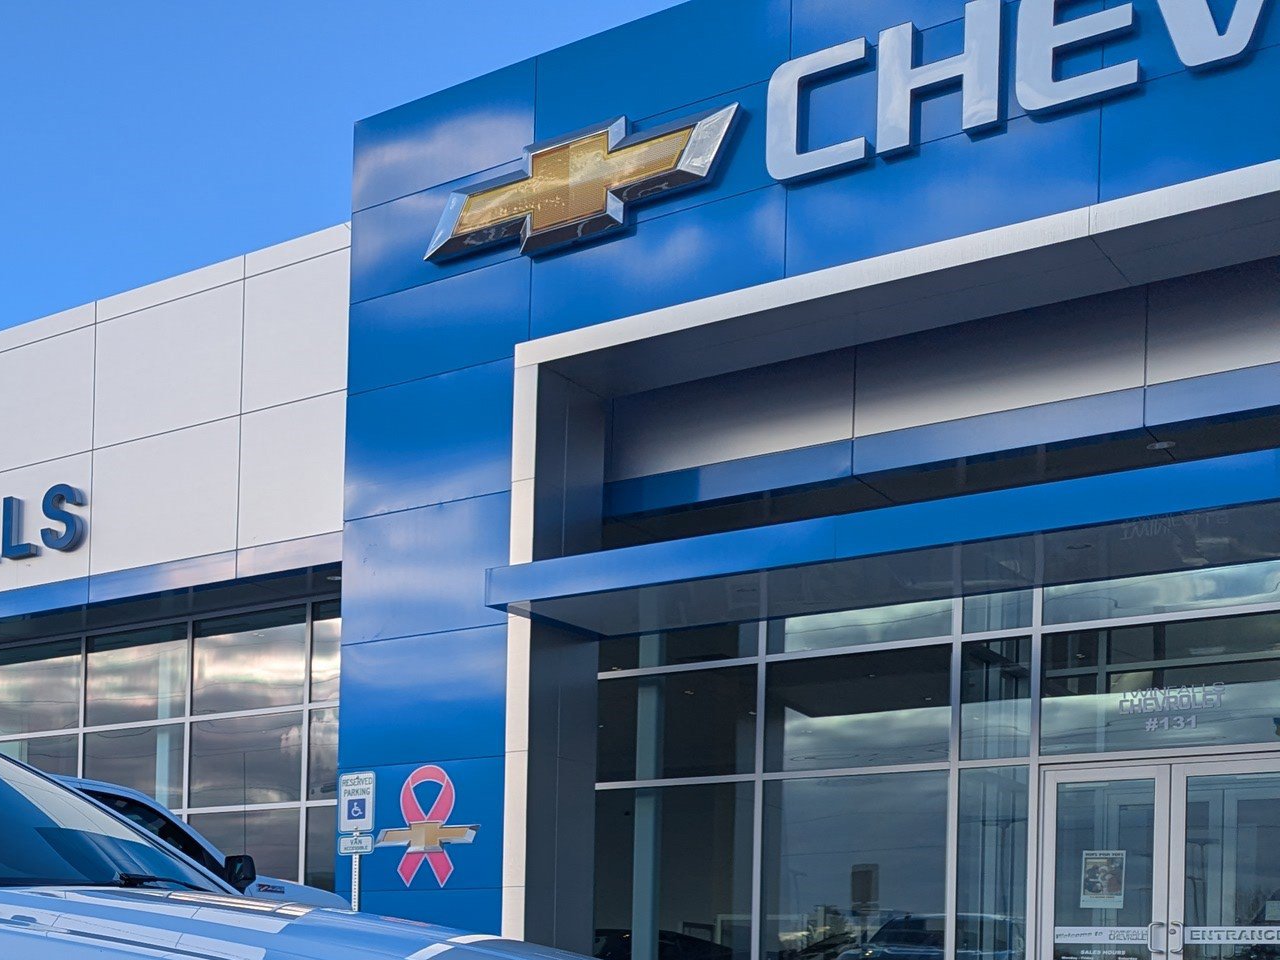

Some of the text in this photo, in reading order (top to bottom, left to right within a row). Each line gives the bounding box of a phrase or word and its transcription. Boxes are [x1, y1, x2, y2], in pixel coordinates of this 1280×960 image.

[766, 0, 1266, 183] CHEV
[1120, 692, 1225, 715] CHEVROLET
[1145, 715, 1198, 732] #131
[342, 777, 373, 787] RESERVED
[343, 788, 371, 798] PARKING
